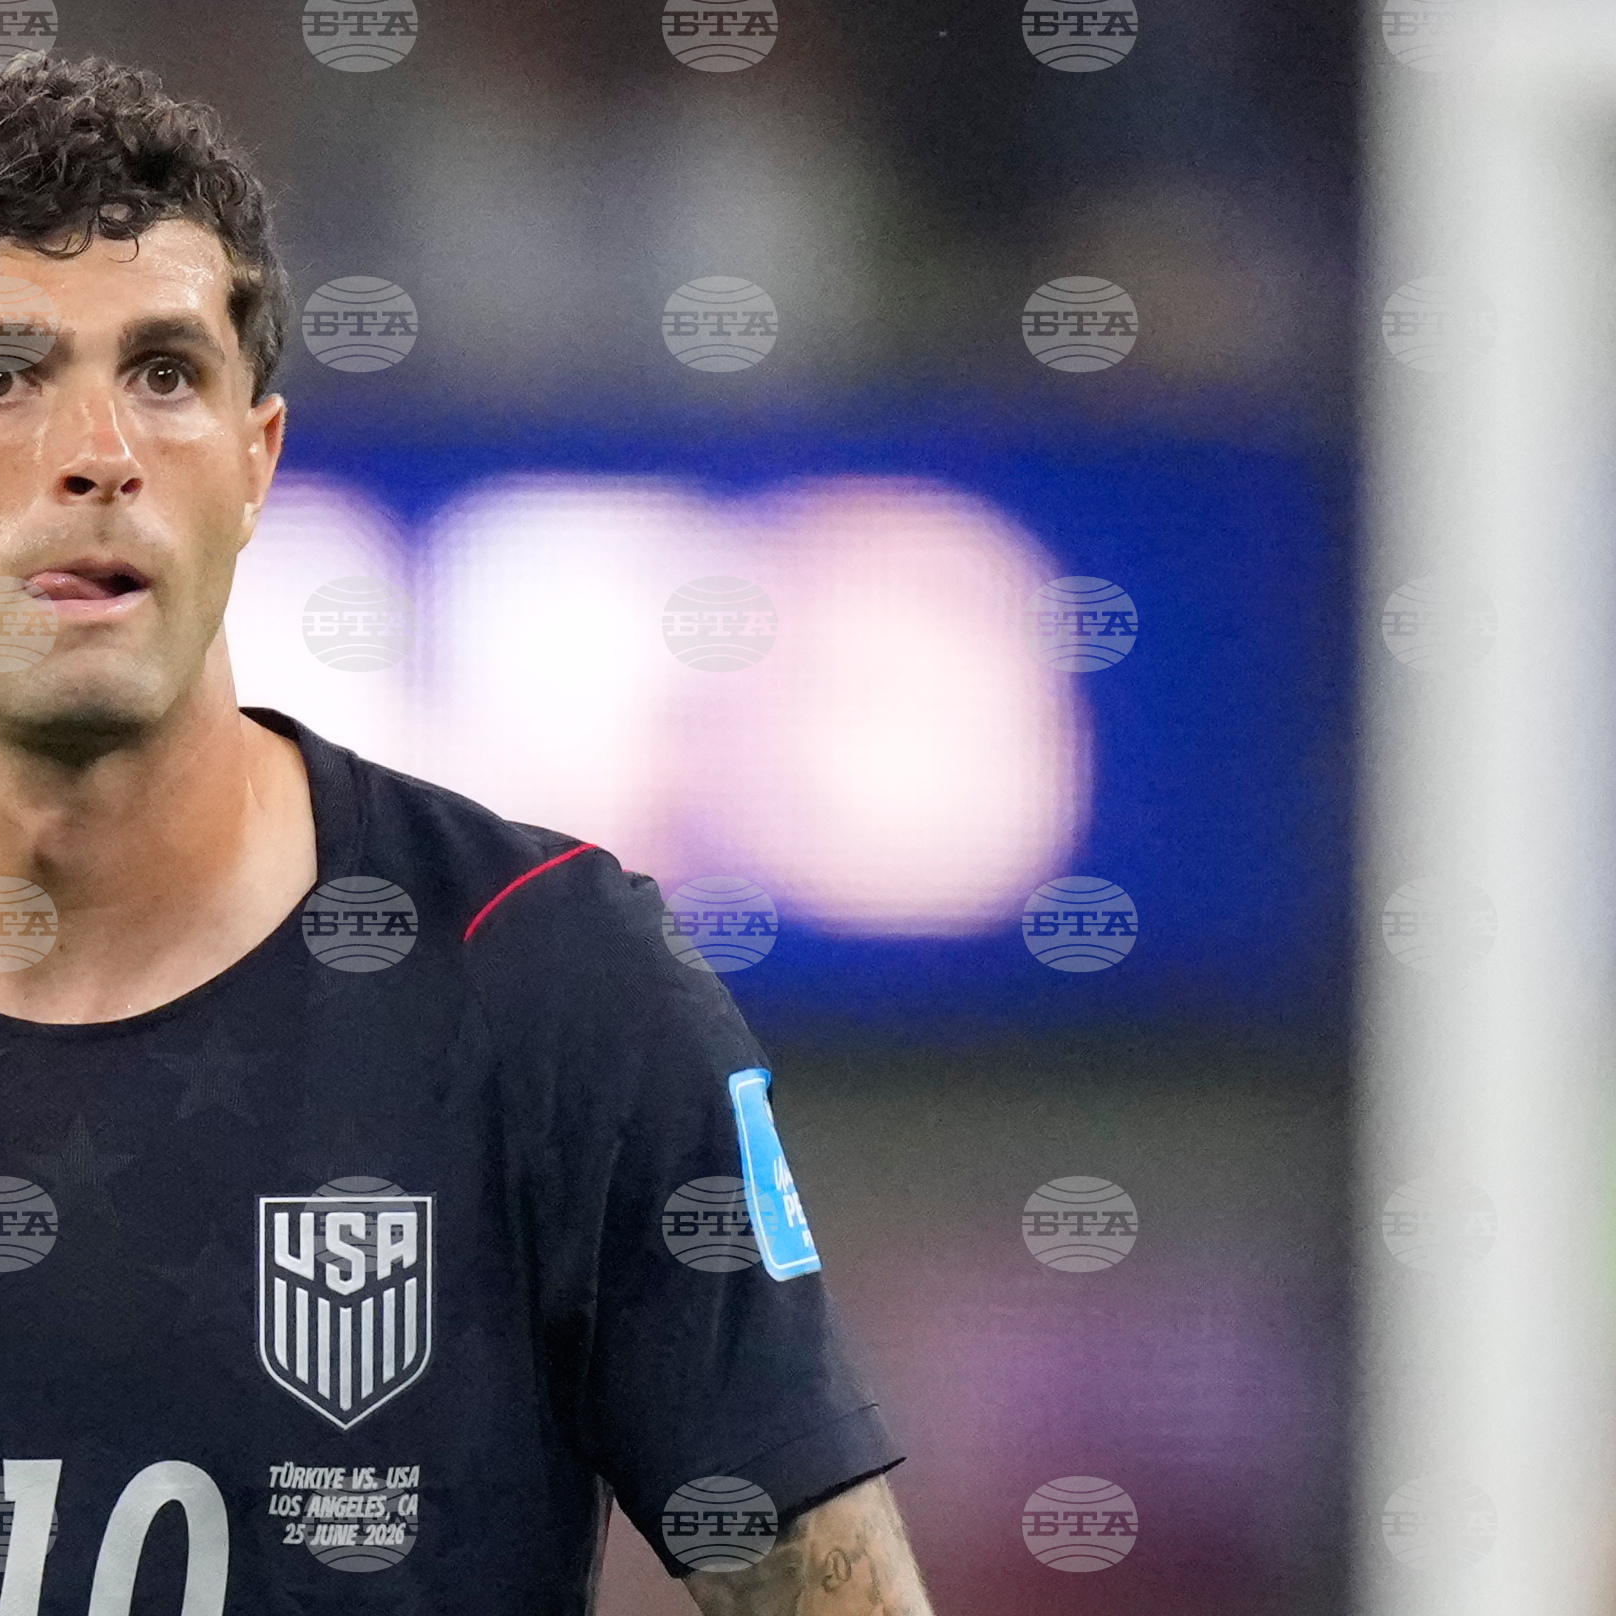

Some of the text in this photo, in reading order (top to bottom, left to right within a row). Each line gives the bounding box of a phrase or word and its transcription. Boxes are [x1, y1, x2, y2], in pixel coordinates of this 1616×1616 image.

[274, 1211, 418, 1296] USA
[352, 1467, 378, 1490] VS.
[386, 1465, 420, 1490] USA
[268, 1494, 419, 1521] LOS ANGELES, CA
[283, 1523, 407, 1546] 25 JUNE 2026
